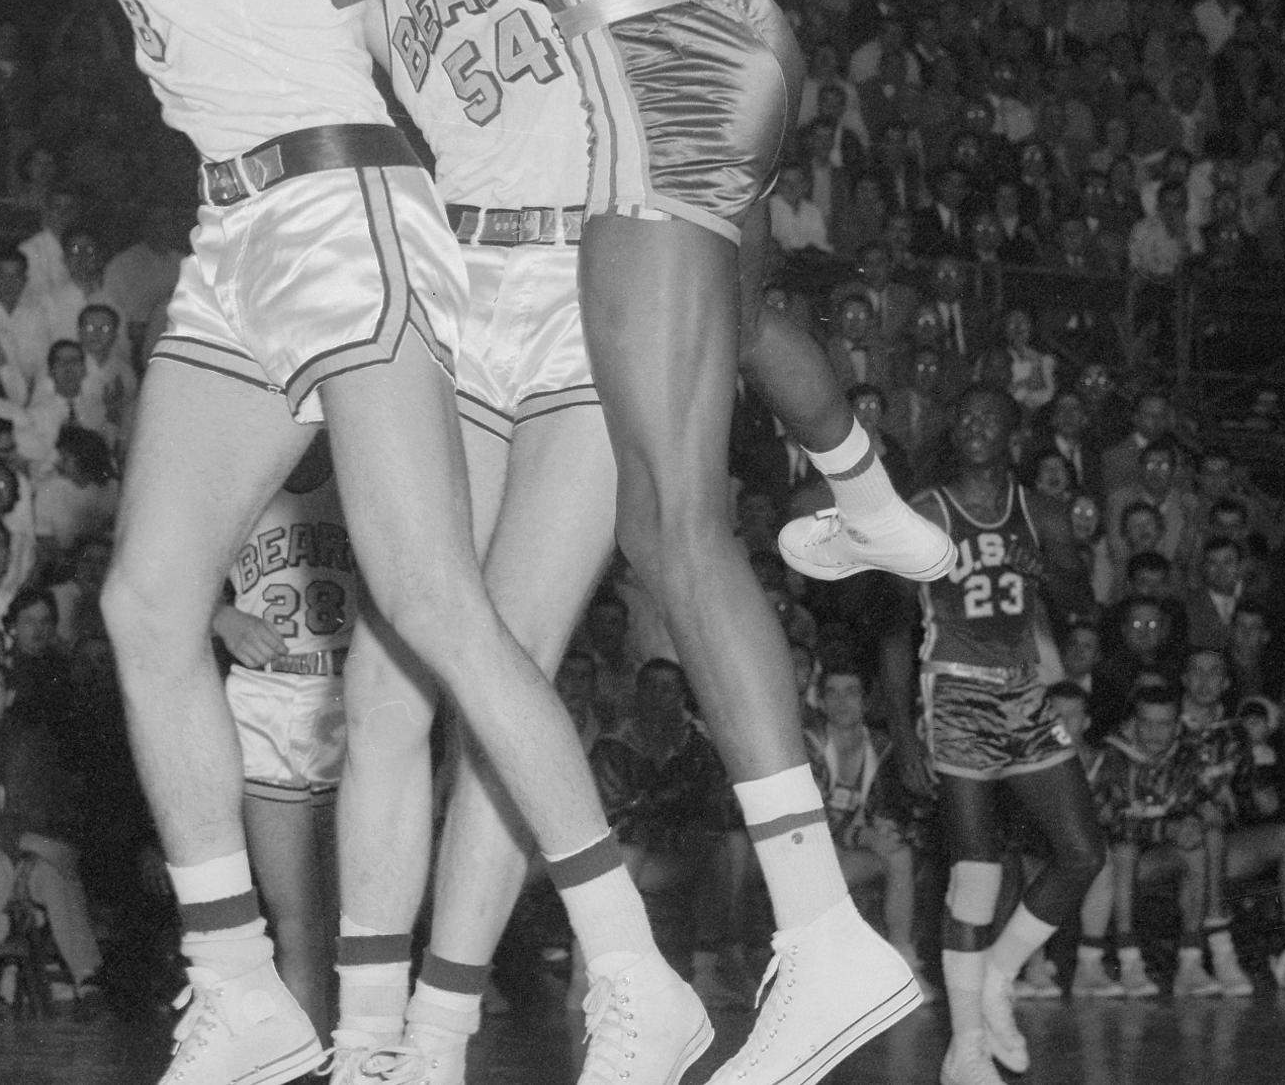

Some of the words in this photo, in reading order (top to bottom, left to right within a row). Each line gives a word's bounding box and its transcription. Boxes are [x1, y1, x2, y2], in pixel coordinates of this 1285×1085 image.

[441, 8, 564, 127] 54
[262, 580, 346, 638] 28
[964, 571, 1024, 619] 23
